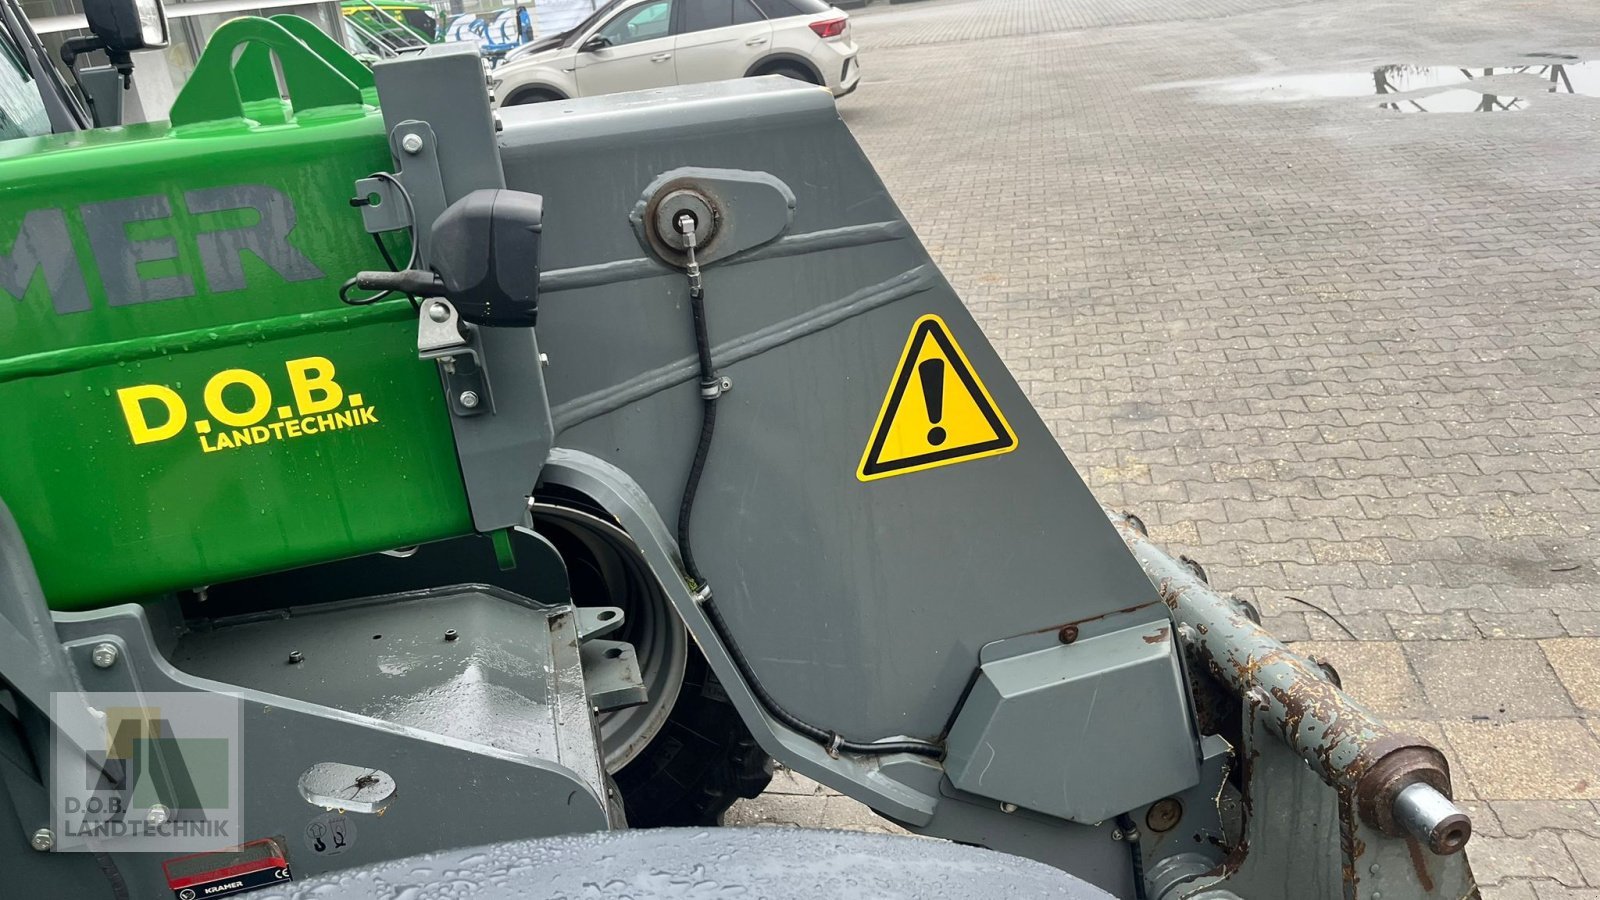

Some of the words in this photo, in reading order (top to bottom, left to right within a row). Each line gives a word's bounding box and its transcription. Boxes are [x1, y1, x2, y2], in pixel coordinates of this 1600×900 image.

[117, 356, 363, 445] D.O.B.
[199, 406, 379, 453] LANDTECHNIK
[204, 880, 244, 894] KRAMER
